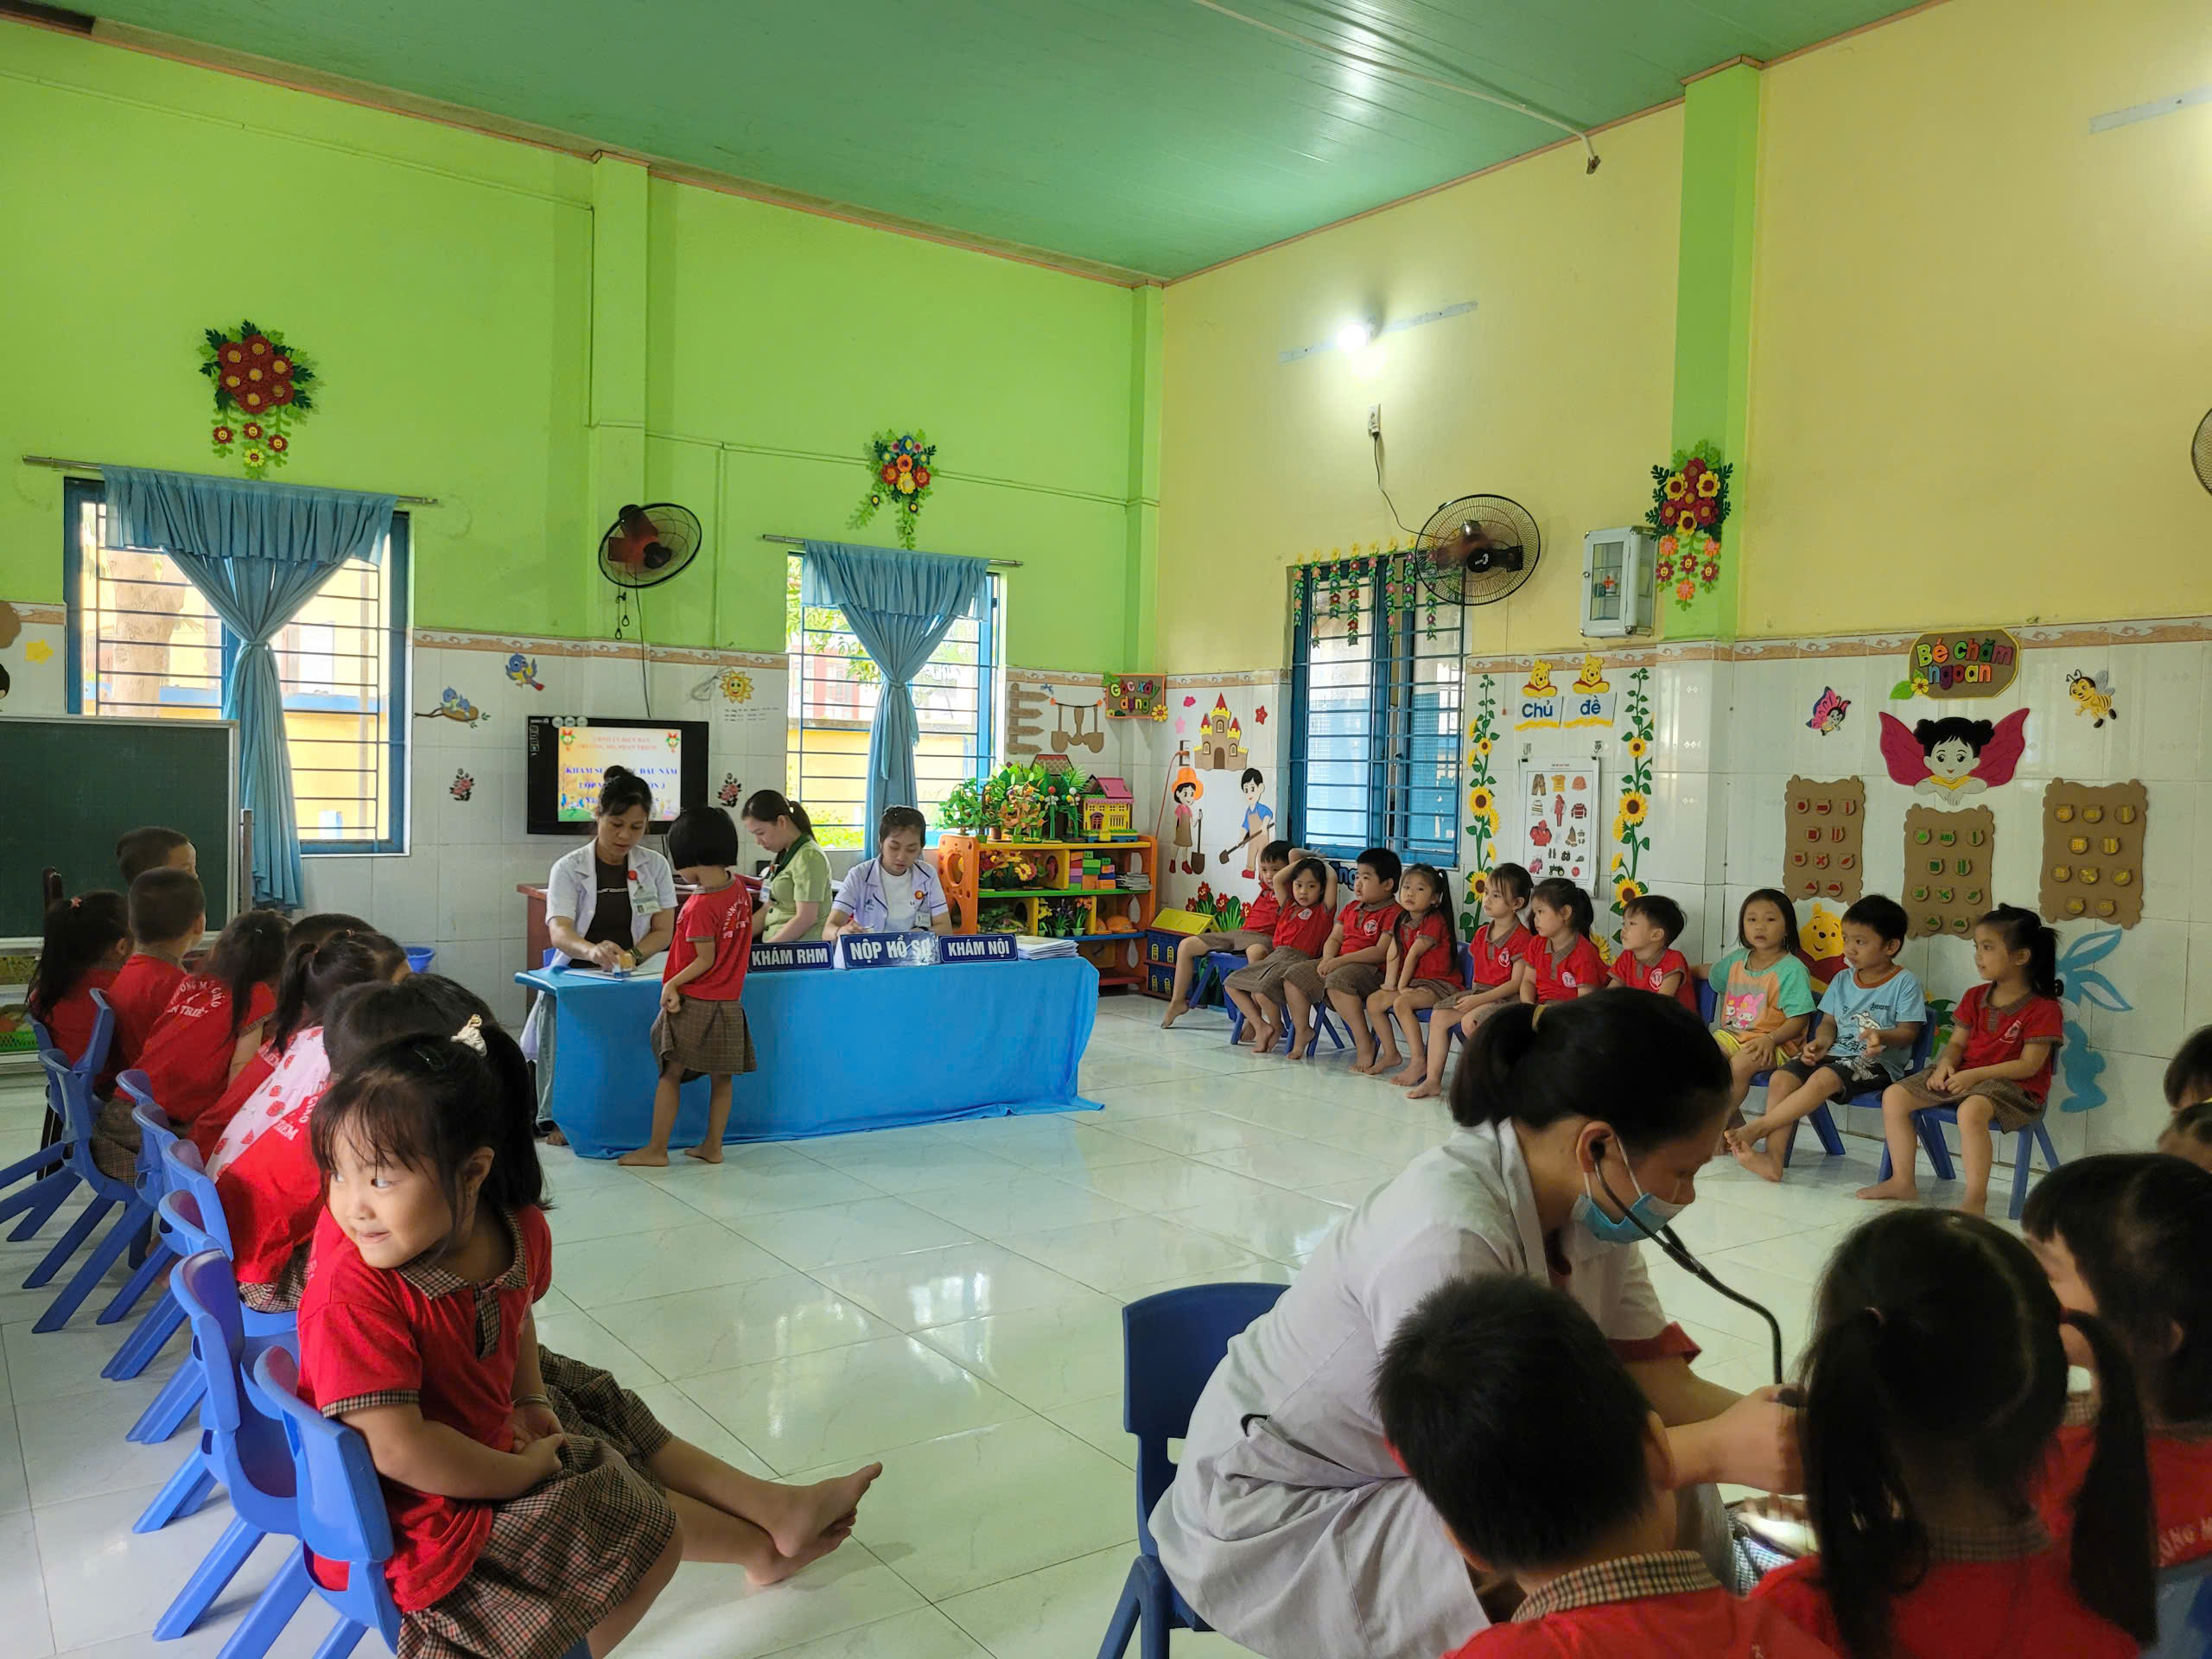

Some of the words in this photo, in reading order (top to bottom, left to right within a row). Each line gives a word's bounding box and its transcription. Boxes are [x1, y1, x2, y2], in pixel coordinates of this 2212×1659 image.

[1916, 638, 1948, 668] Bé
[1928, 664, 1992, 690] ngoan
[1580, 695, 1601, 715] đề
[752, 947, 793, 966] KHÁM
[797, 948, 829, 964] RHM
[849, 938, 881, 963] NỘP
[886, 935, 906, 958] HỒ
[947, 938, 985, 957] KHÁM
[988, 938, 1010, 957] NỘI
